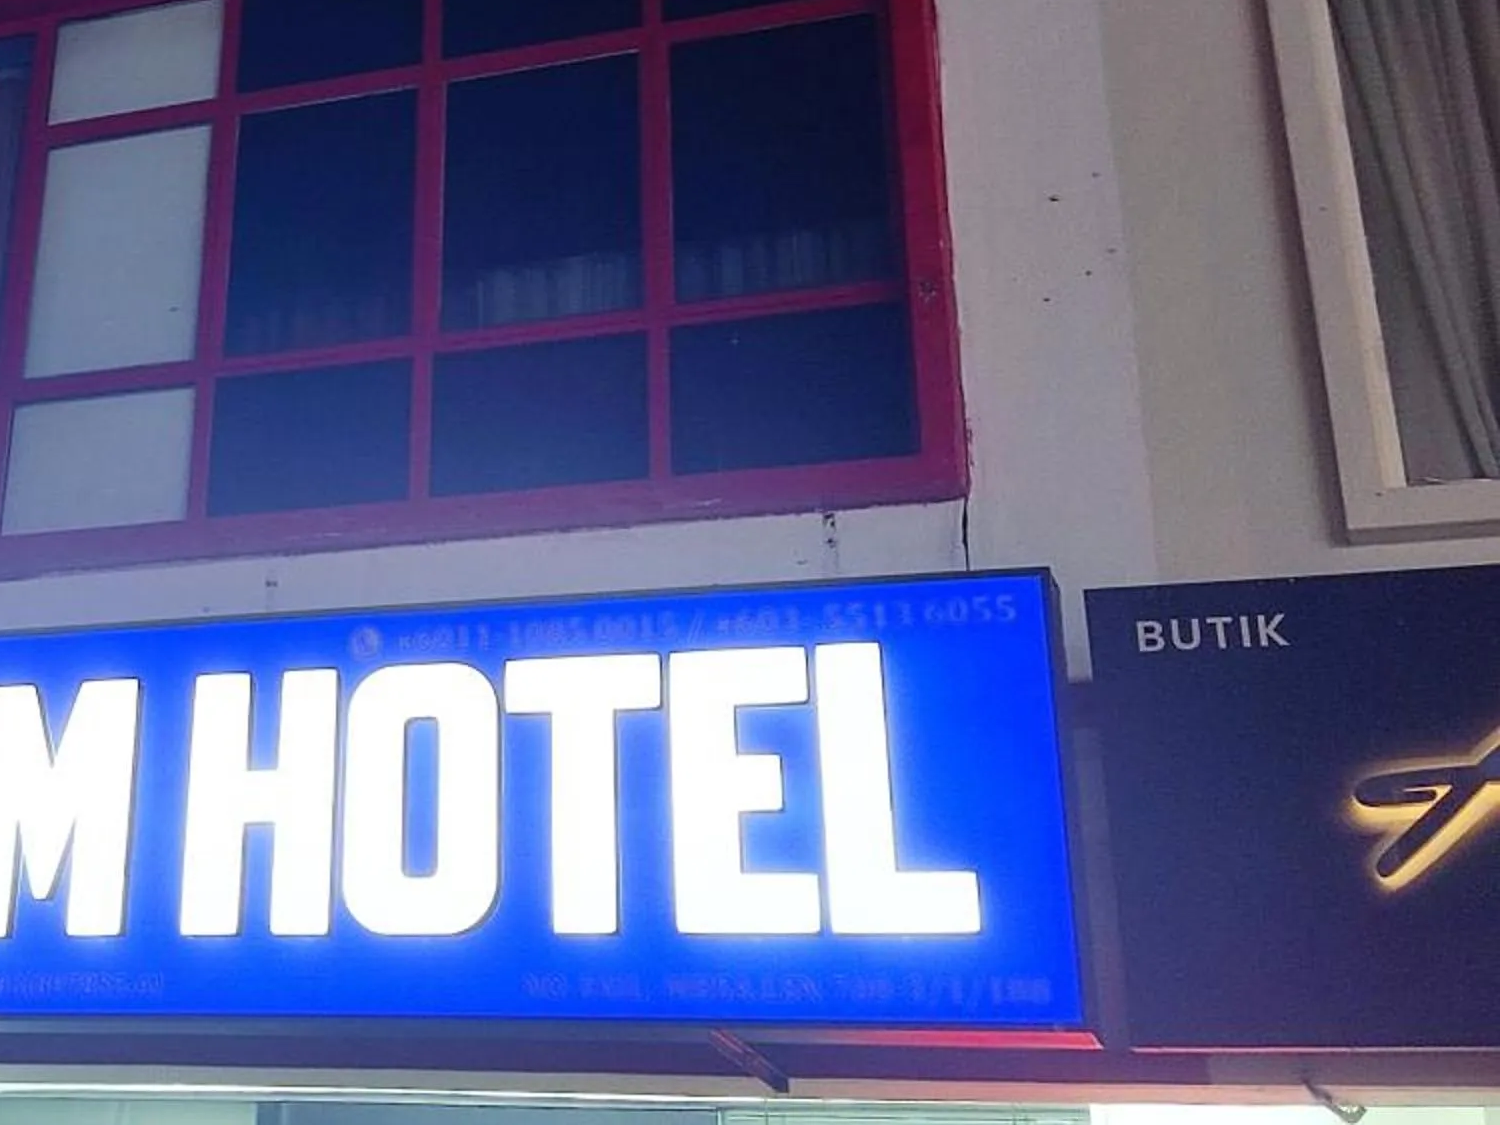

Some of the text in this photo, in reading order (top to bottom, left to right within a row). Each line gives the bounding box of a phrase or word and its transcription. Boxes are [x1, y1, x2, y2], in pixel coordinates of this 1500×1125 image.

[922, 594, 1018, 624] 6055
[1135, 612, 1291, 653] BUTIK
[178, 641, 982, 938] HOTEL
